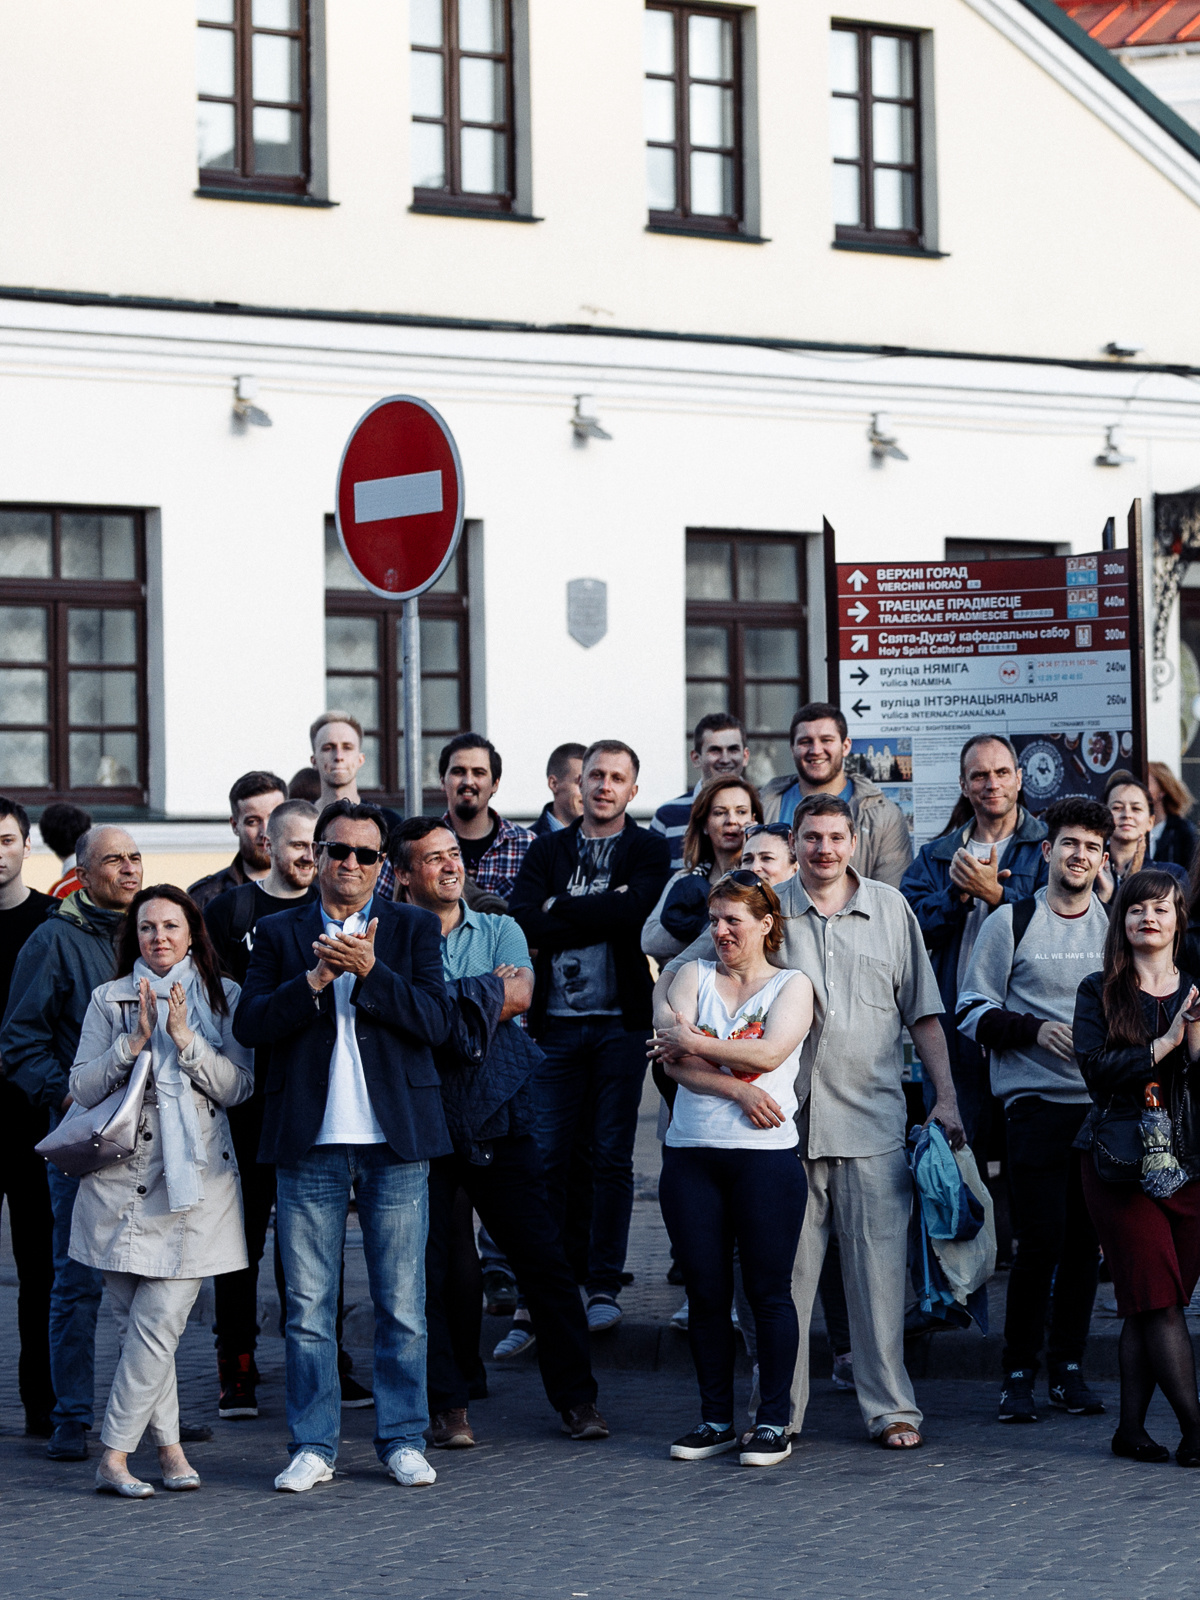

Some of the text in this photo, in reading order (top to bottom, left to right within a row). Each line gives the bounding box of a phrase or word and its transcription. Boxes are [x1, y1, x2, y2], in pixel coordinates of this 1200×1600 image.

[876, 566, 968, 580] ВЕРХНІ ГОРАД
[878, 582, 925, 592] VIERCHNI
[926, 580, 962, 590] HORAD
[878, 596, 1022, 612] ТРАЕЦКАЕ ПРАДМЕСЦЕ
[878, 612, 943, 624] TRAJECKAJE
[945, 610, 1008, 622] PRADMIESCIE
[878, 626, 1070, 645] Свята-Духаў кафедральны сабор
[878, 646, 900, 658] Holy
[902, 646, 928, 656] Spirit
[930, 644, 974, 654] Cathedral
[880, 663, 969, 678] вуліца НЯМІГА
[880, 678, 952, 687] vulica NIAMIHA
[881, 692, 1058, 710] вуліца ІНТЭРНАЦЫЯНАЛЬНАЯ
[881, 711, 909, 719] vulica
